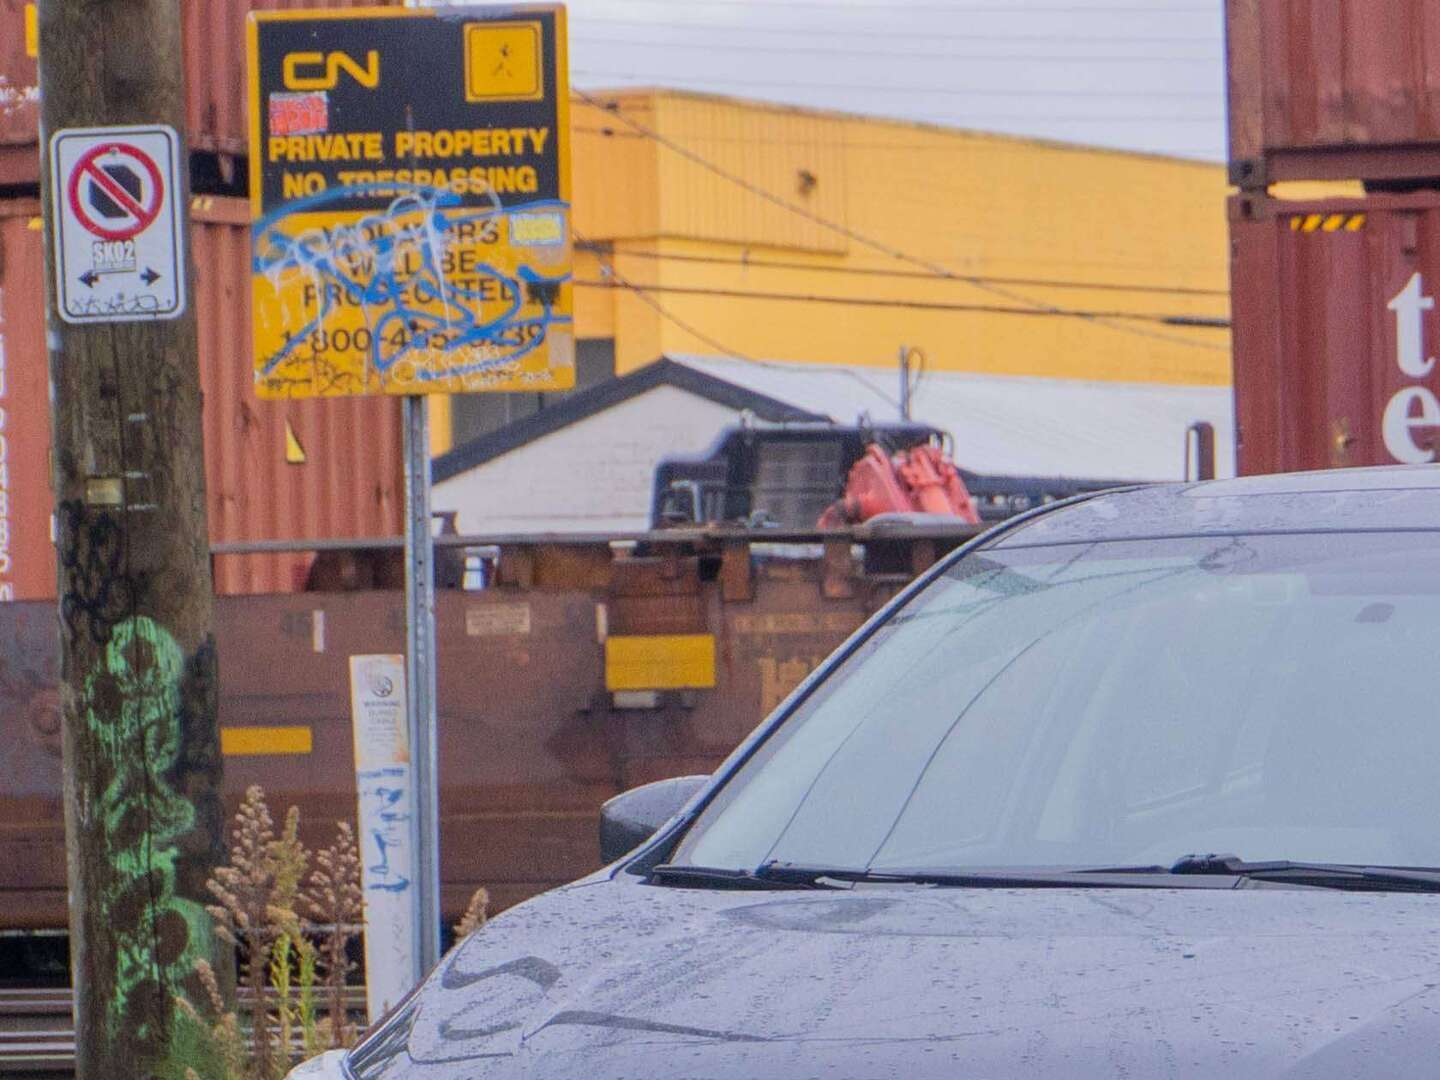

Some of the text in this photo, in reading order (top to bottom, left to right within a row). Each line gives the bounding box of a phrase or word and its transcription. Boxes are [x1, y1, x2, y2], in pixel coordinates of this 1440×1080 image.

[282, 50, 380, 90] CN
[268, 127, 548, 162] PRIVATE PROPERTY
[282, 170, 327, 198] NO
